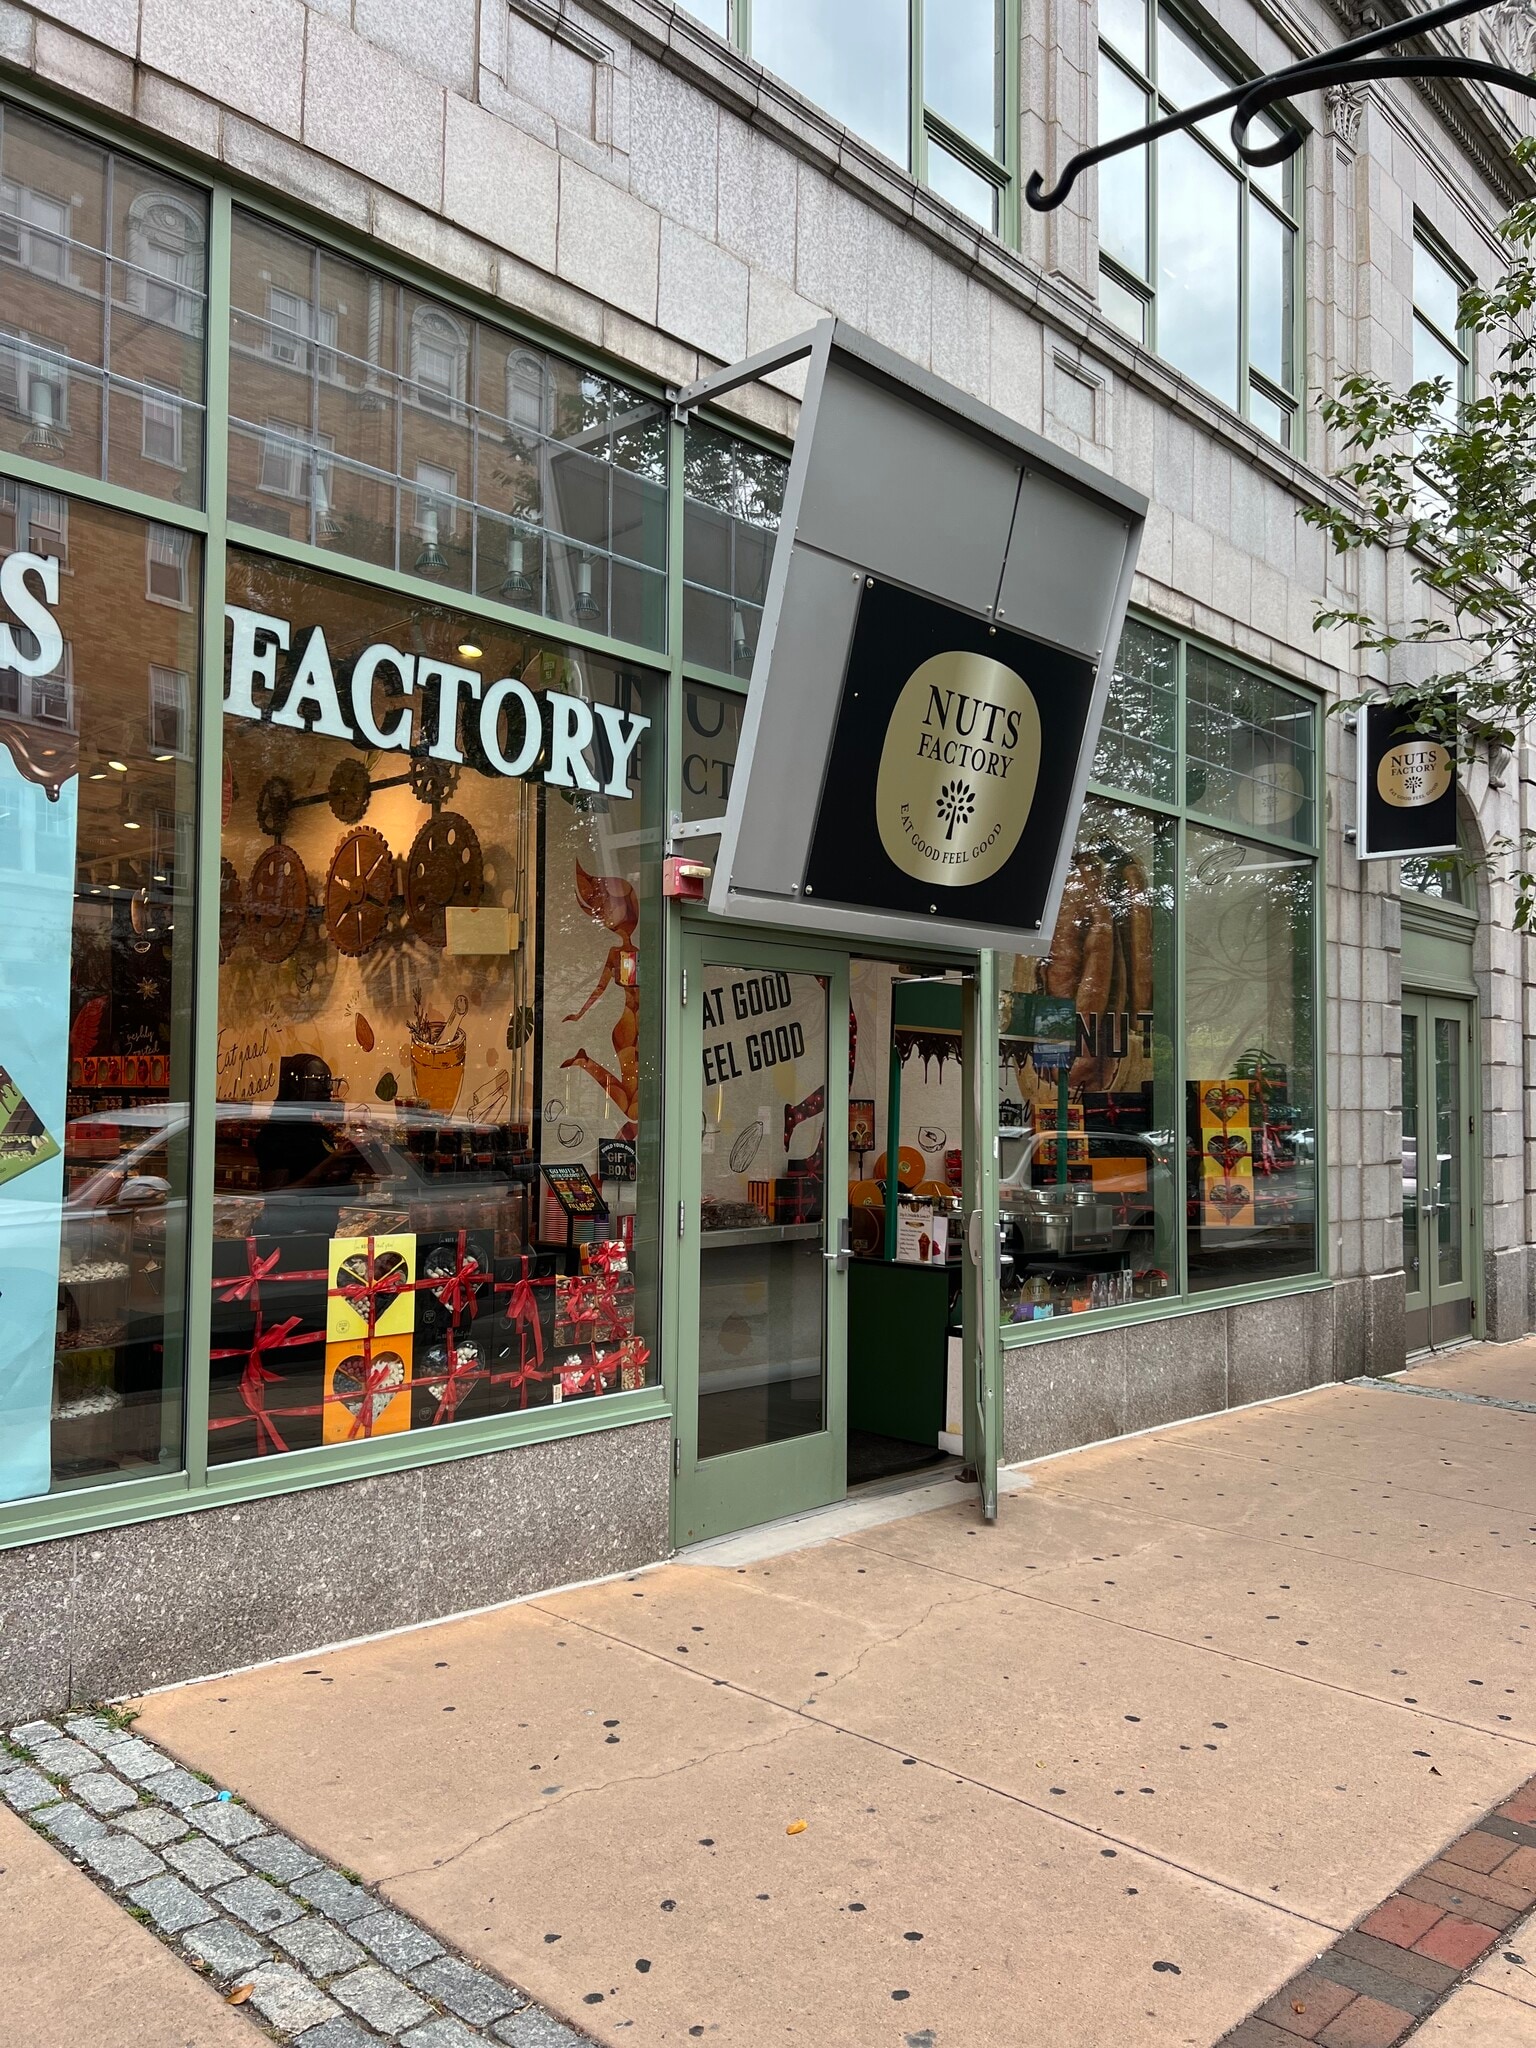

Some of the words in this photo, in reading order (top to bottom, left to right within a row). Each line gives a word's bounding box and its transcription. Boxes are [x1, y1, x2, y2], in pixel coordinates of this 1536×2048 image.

[223, 602, 652, 800] FACTORY
[922, 684, 1022, 749] NUTS
[917, 732, 1014, 779] FACTORY
[1391, 751, 1437, 768] NUTS
[1391, 763, 1437, 777] FACTORY
[1425, 782, 1439, 796] GOOD
[901, 803, 914, 833] EAT
[911, 833, 940, 861] GOOD
[942, 851, 969, 864] FEEL
[972, 823, 1002, 858] GOOD
[731, 972, 792, 1020] GOOD
[239, 1028, 270, 1080] good
[745, 1021, 805, 1072] GOOD
[608, 1152, 628, 1163] GIFT
[608, 1164, 628, 1176] BOX
[1026, 1284, 1046, 1295] NUTS
